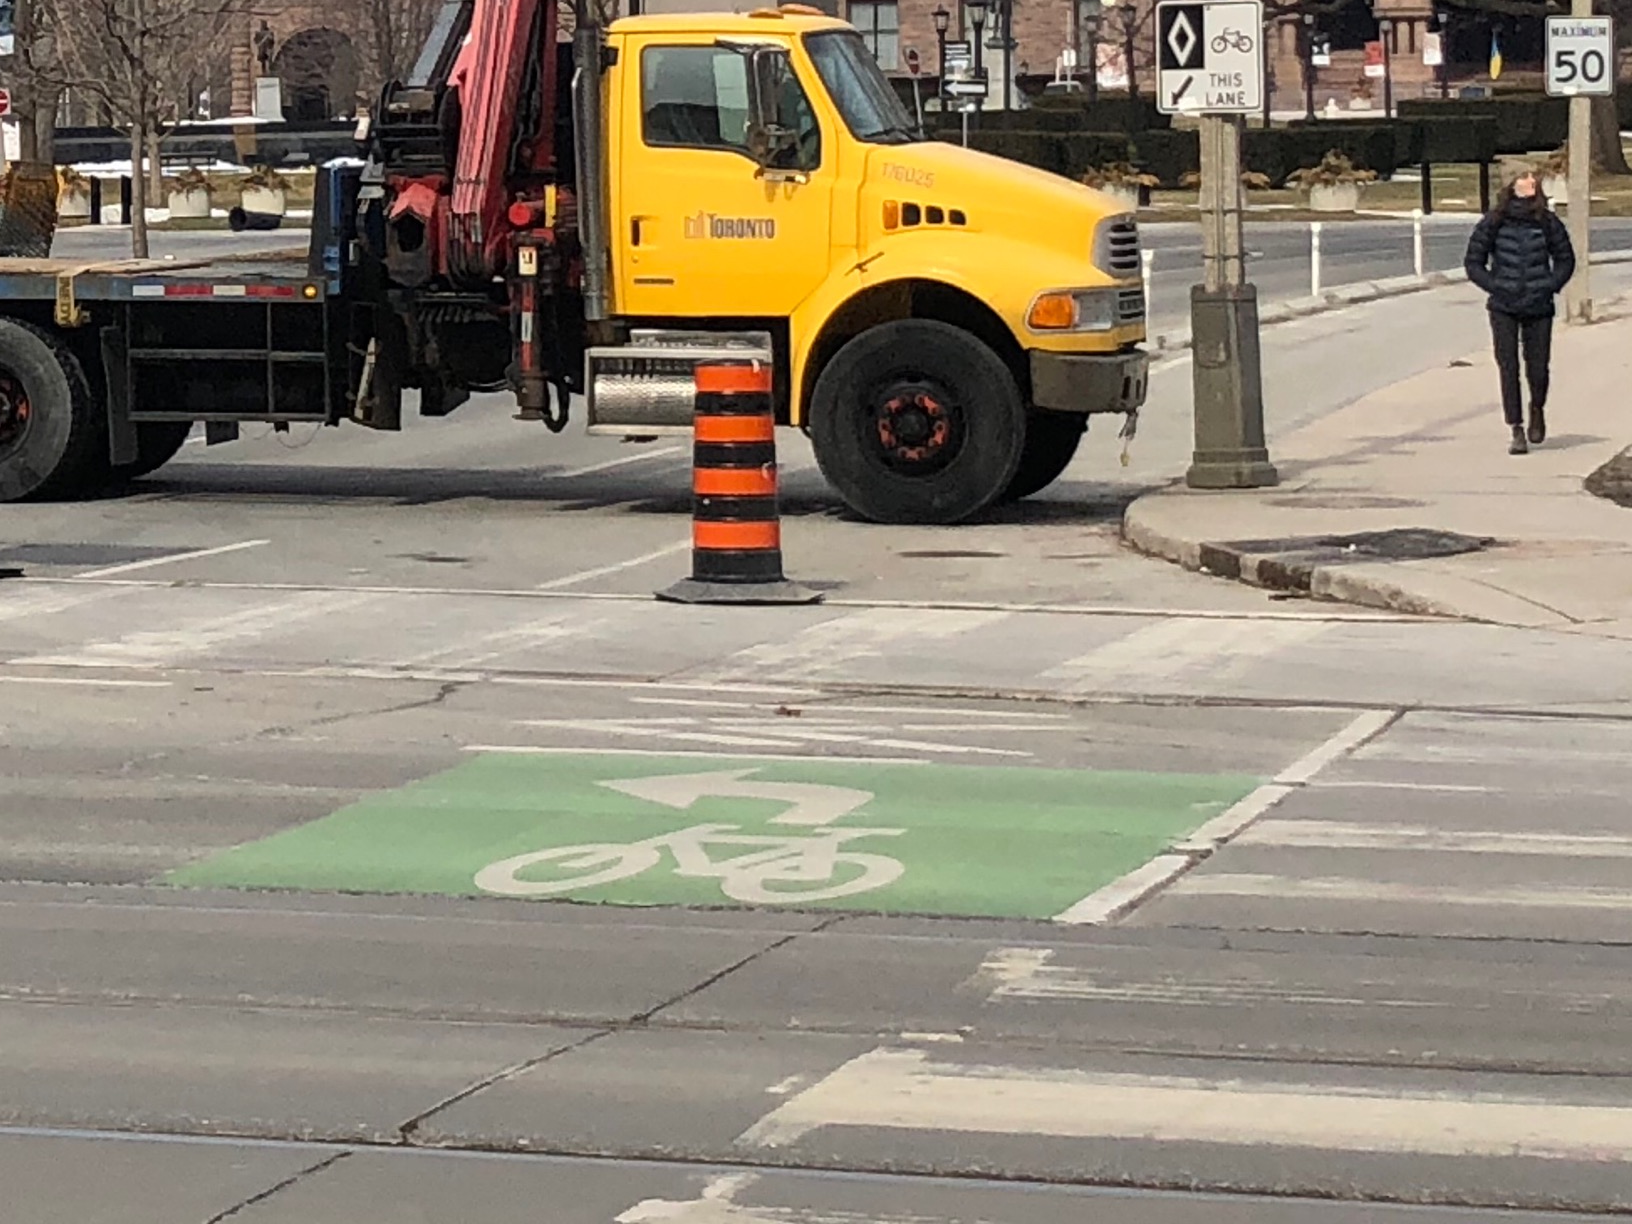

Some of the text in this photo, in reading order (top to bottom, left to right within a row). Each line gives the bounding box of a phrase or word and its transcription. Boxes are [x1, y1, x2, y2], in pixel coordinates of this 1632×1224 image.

[1554, 49, 1605, 83] 50
[1209, 72, 1243, 87] THIS
[1205, 91, 1246, 106] LANE
[707, 213, 775, 239] TORONTO
